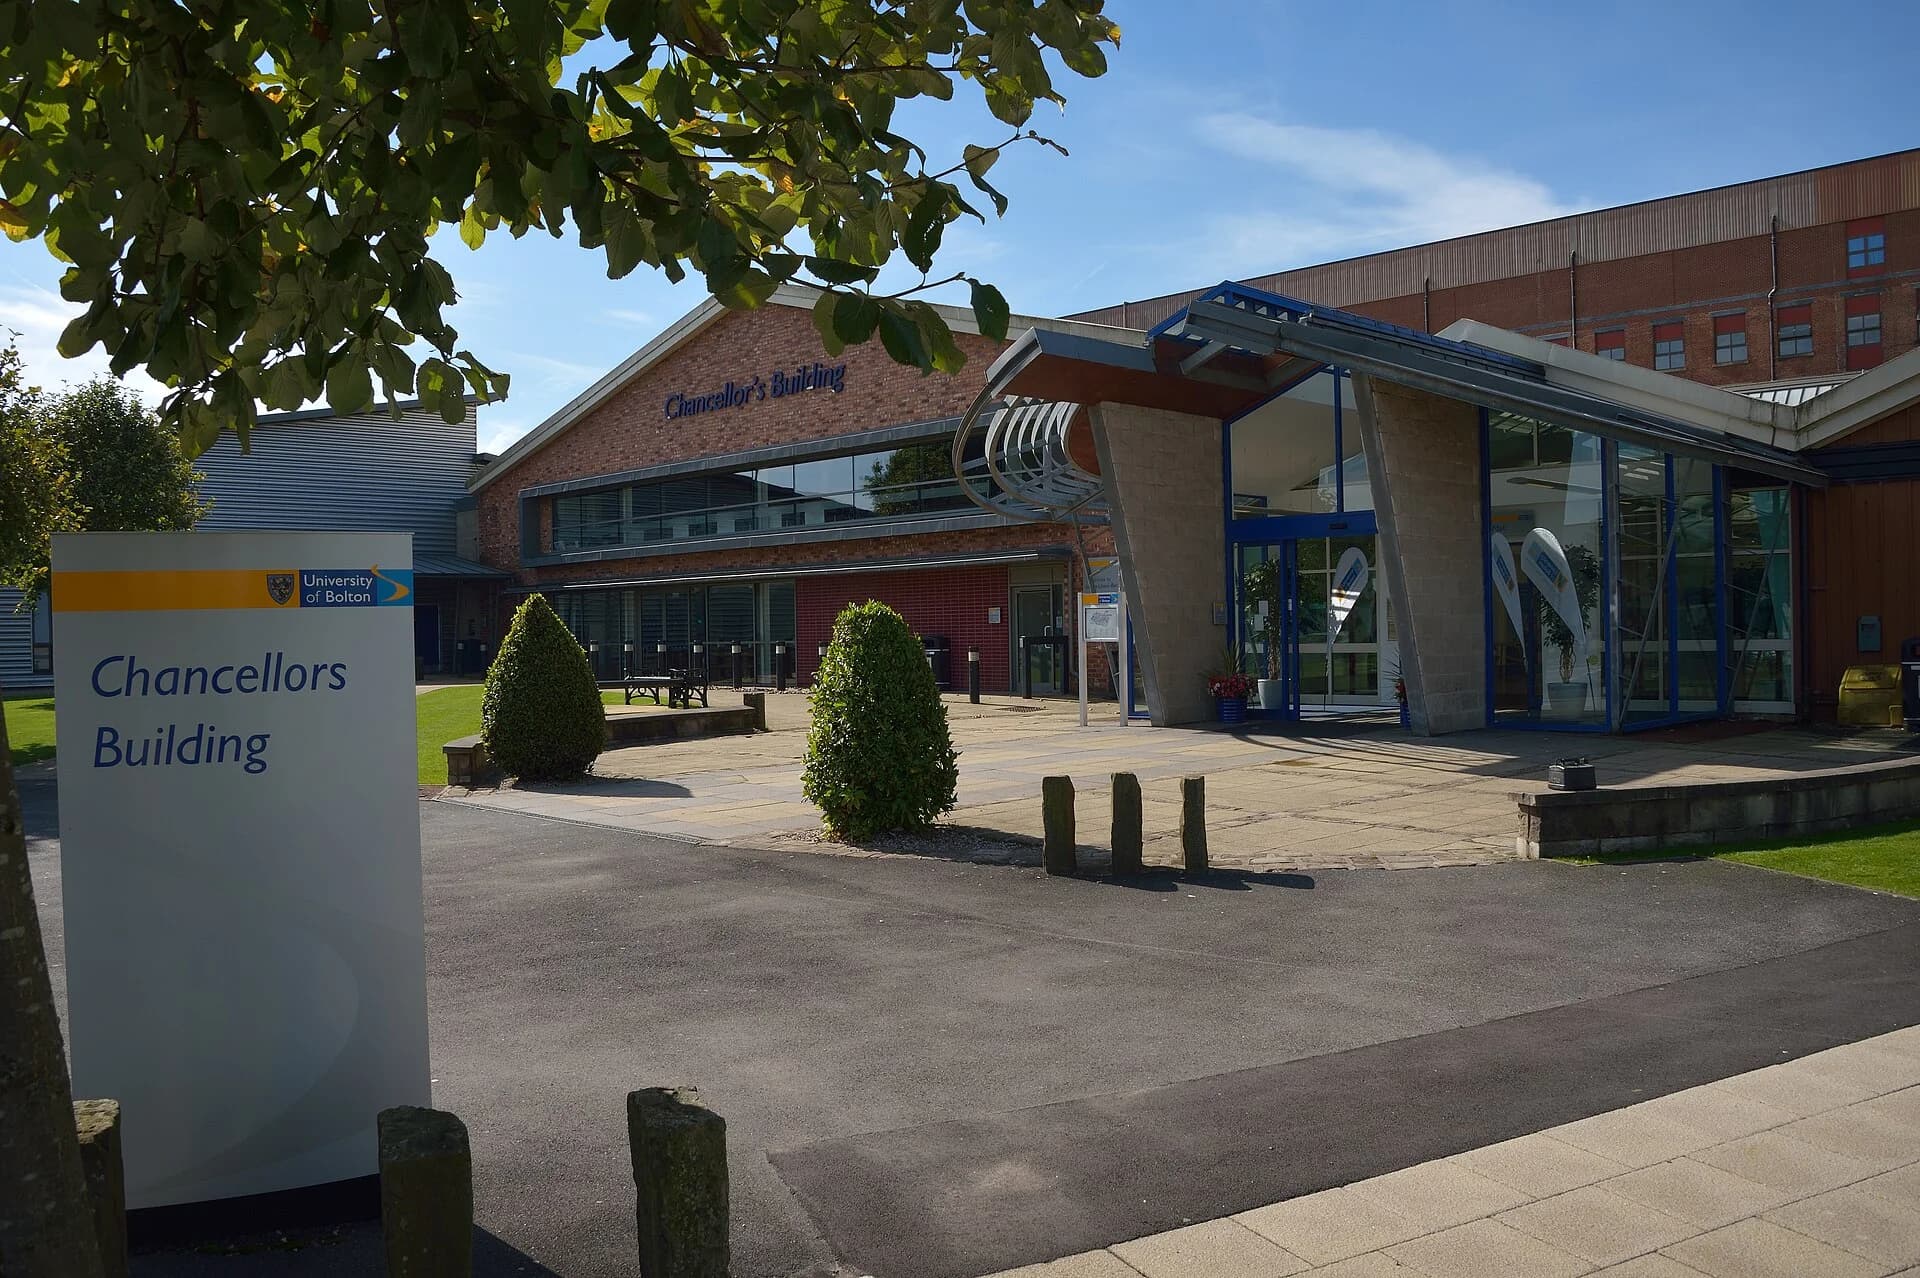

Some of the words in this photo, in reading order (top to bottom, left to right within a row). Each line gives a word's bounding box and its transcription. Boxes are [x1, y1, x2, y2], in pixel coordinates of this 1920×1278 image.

[664, 376, 766, 420] Chancellor's
[770, 362, 846, 399] Building
[303, 574, 373, 590] University
[306, 590, 322, 603] of
[325, 590, 371, 603] Bolton
[91, 651, 348, 698] Chancellors
[93, 723, 271, 774] Building
